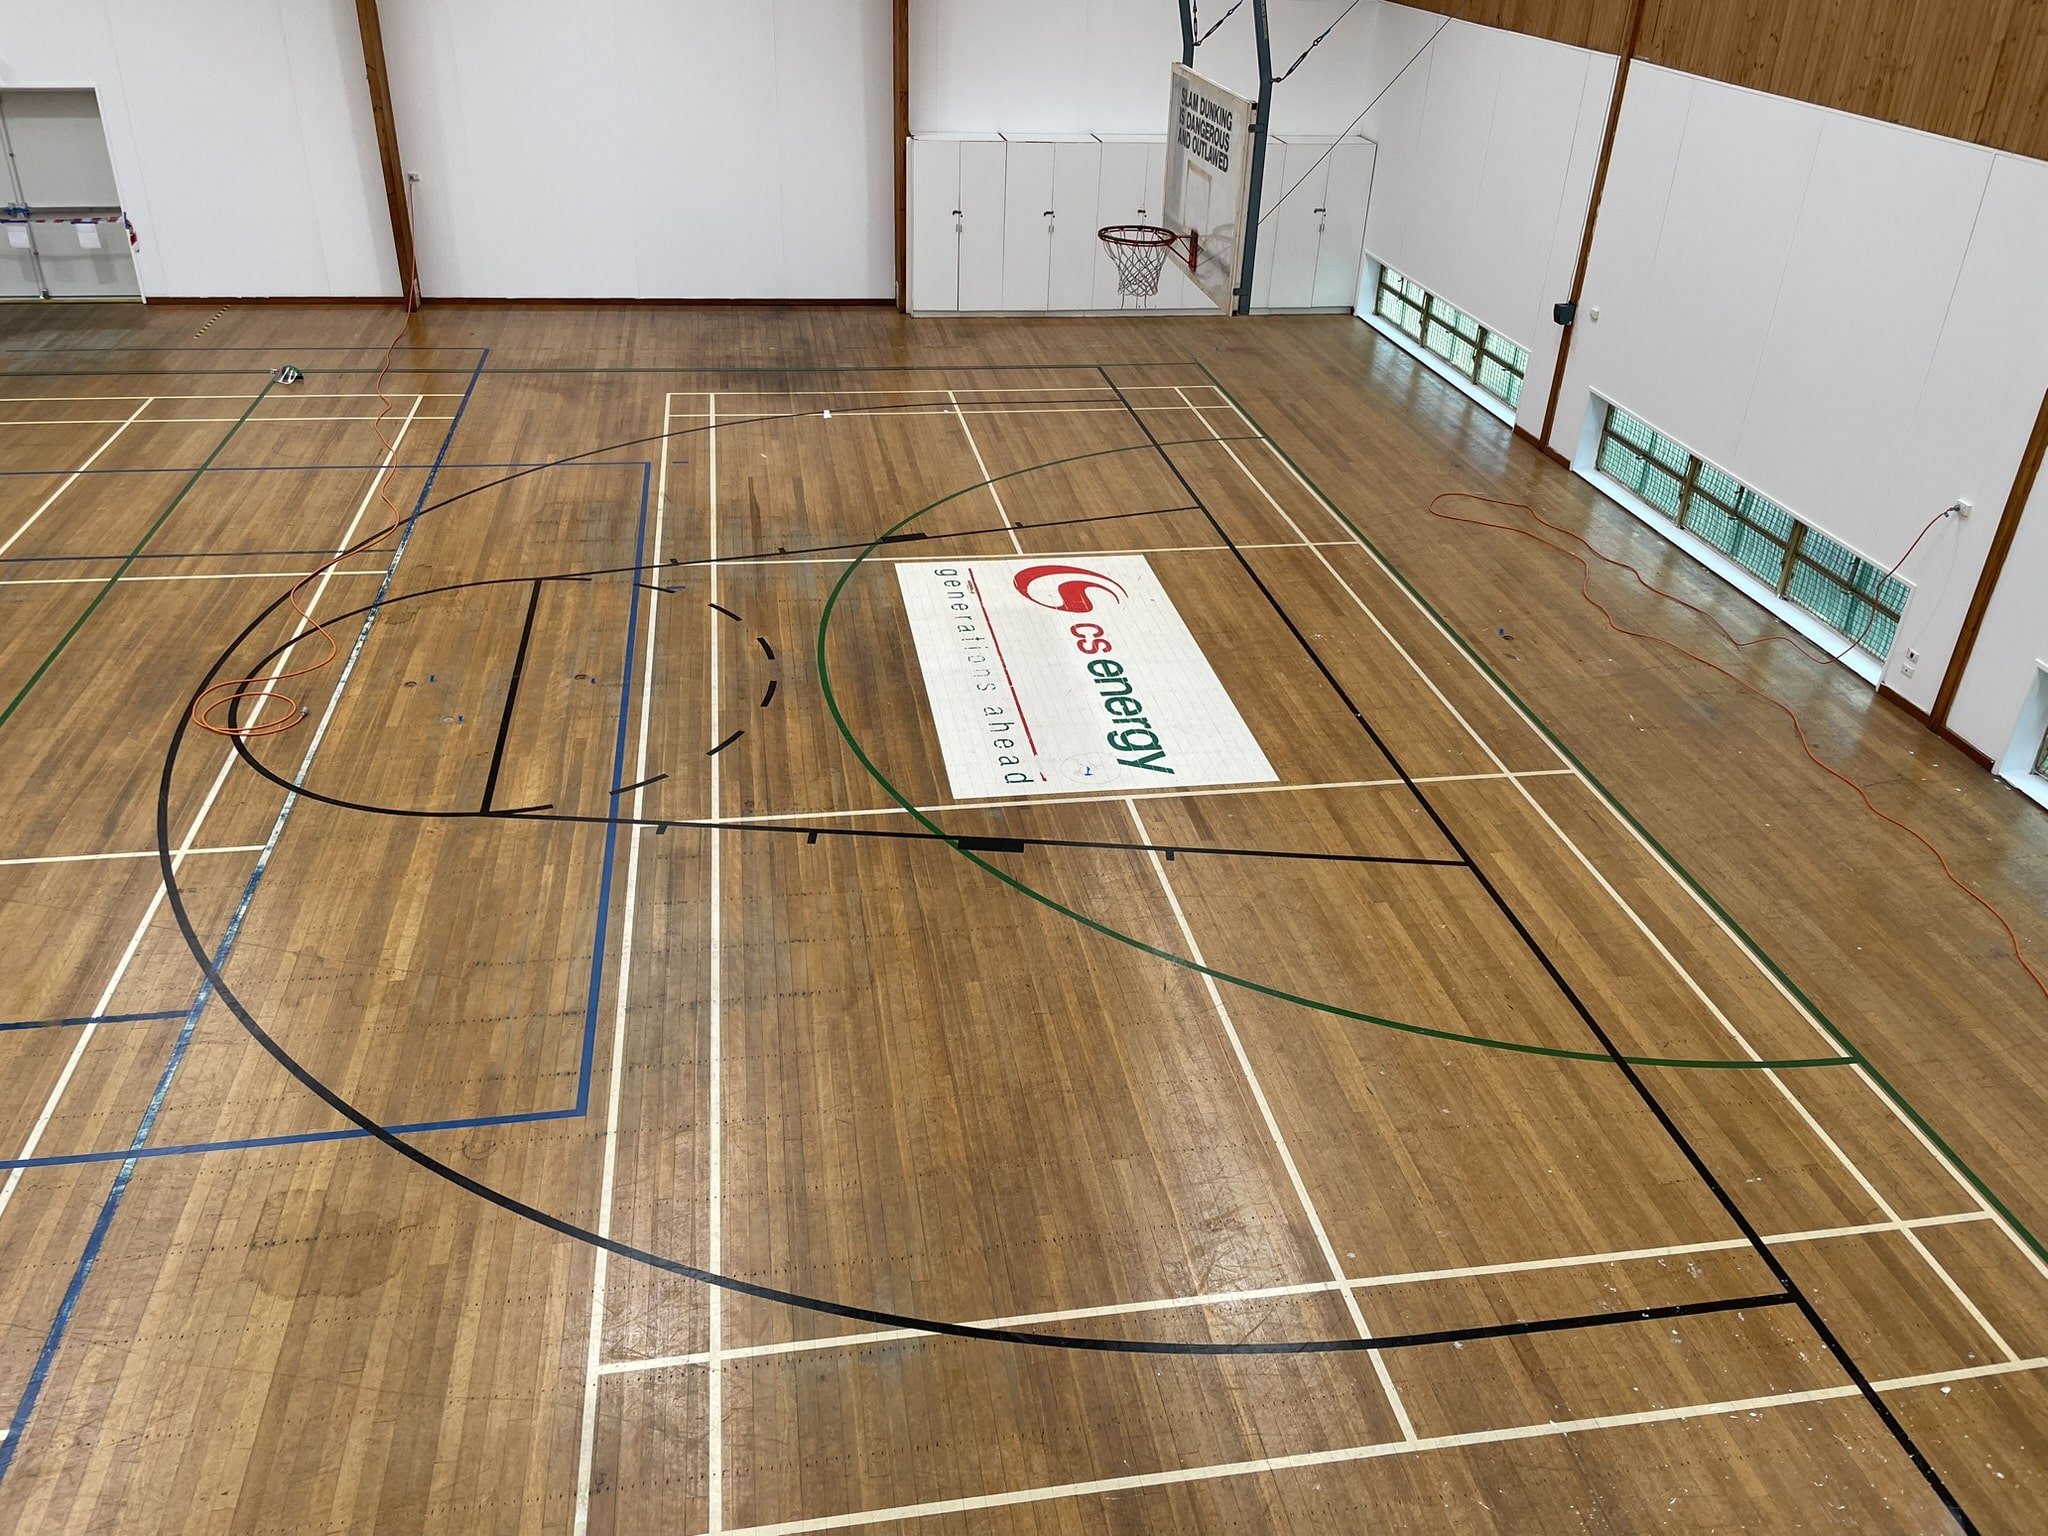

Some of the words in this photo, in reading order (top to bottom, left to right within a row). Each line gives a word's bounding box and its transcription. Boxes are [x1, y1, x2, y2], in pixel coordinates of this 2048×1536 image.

[1179, 106, 1186, 126] IS
[1186, 112, 1230, 152] DANGEROUS
[1181, 87, 1199, 113] SLAM
[1200, 97, 1233, 131] DUNKING
[1177, 128, 1191, 149] AND
[1192, 135, 1229, 173] OUTLAWED
[1070, 622, 1113, 655] cs
[934, 568, 996, 692] generations
[983, 706, 1035, 784] ahead
[1087, 659, 1175, 775] energy
